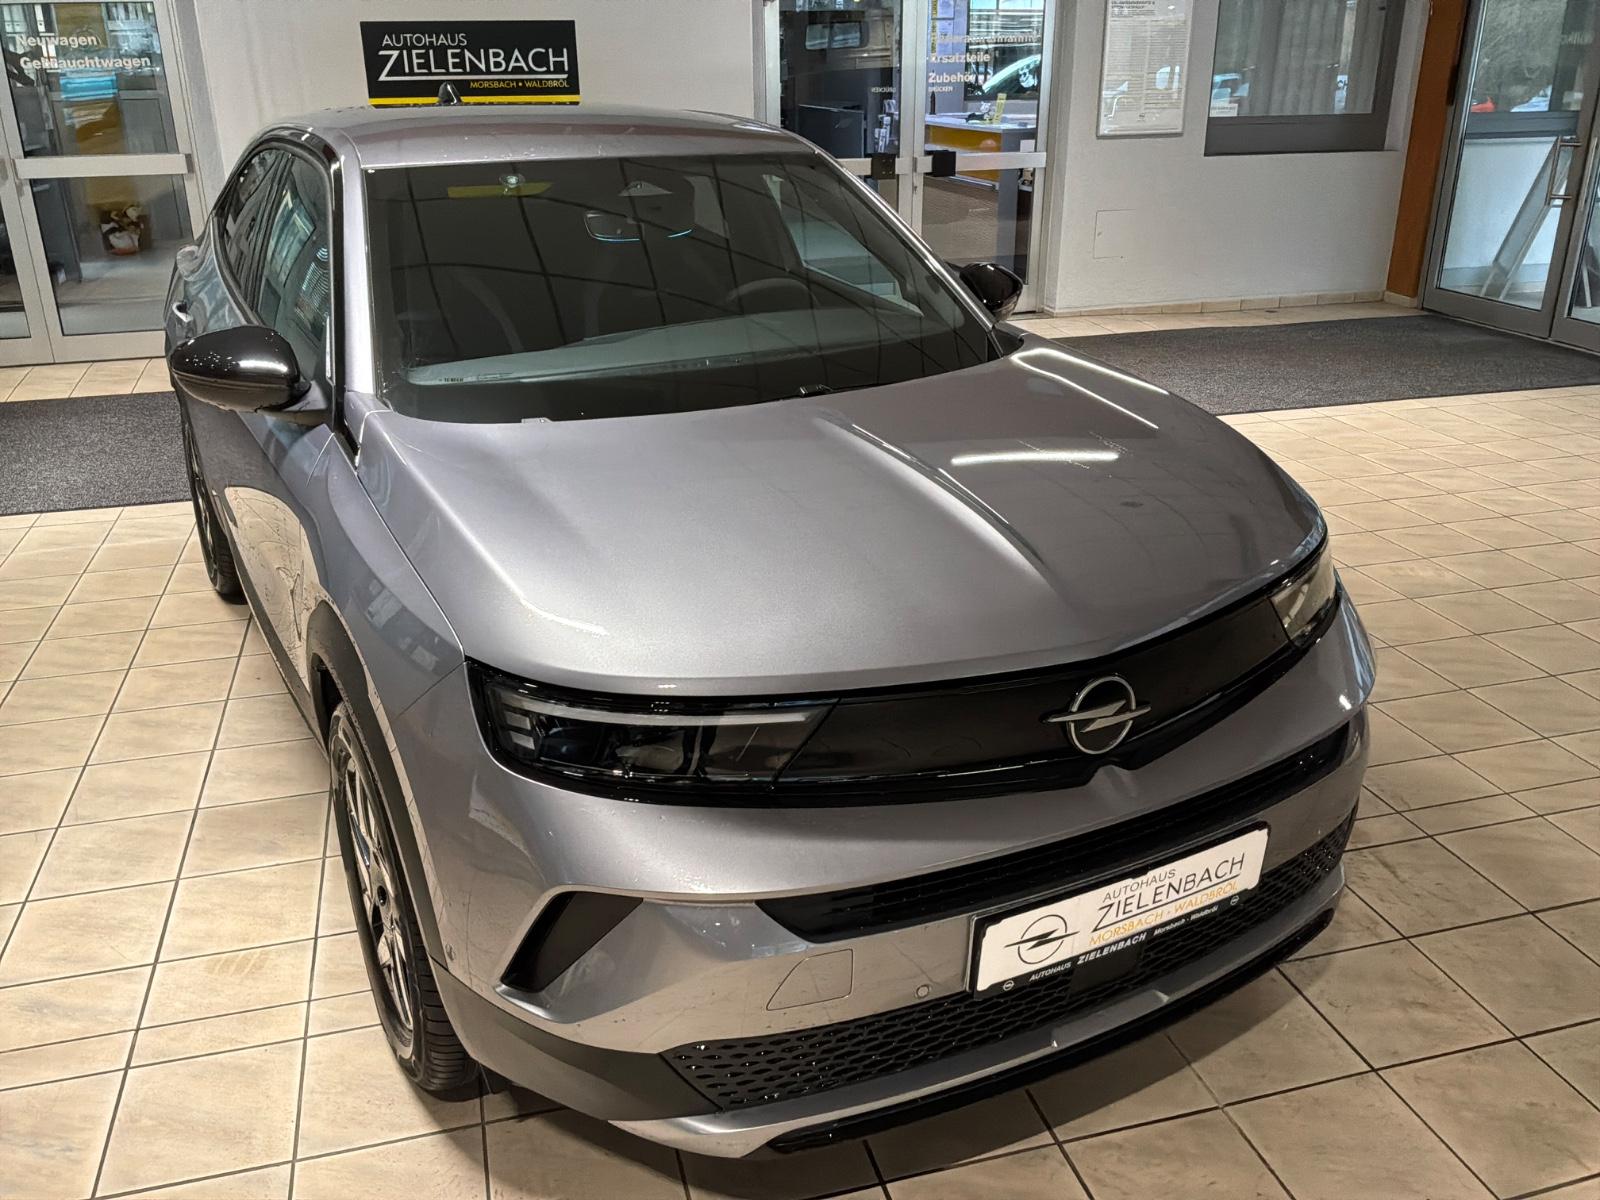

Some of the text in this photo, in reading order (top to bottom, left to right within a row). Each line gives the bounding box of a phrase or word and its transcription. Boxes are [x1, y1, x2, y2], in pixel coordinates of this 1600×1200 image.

[15, 35, 98, 48] Neuwagen
[382, 33, 467, 47] AUTOHAUS
[377, 47, 569, 82] ZIELENBACH
[470, 79, 570, 89] MORSBACH WALDBRÖL
[1091, 852, 1245, 933] ZIELENBACH
[1103, 868, 1177, 903] AUTOHAUS
[1088, 910, 1164, 947] MORSBACH
[1029, 961, 1072, 982] AUTOHAUS
[1077, 932, 1147, 965] ZIELENBACH
